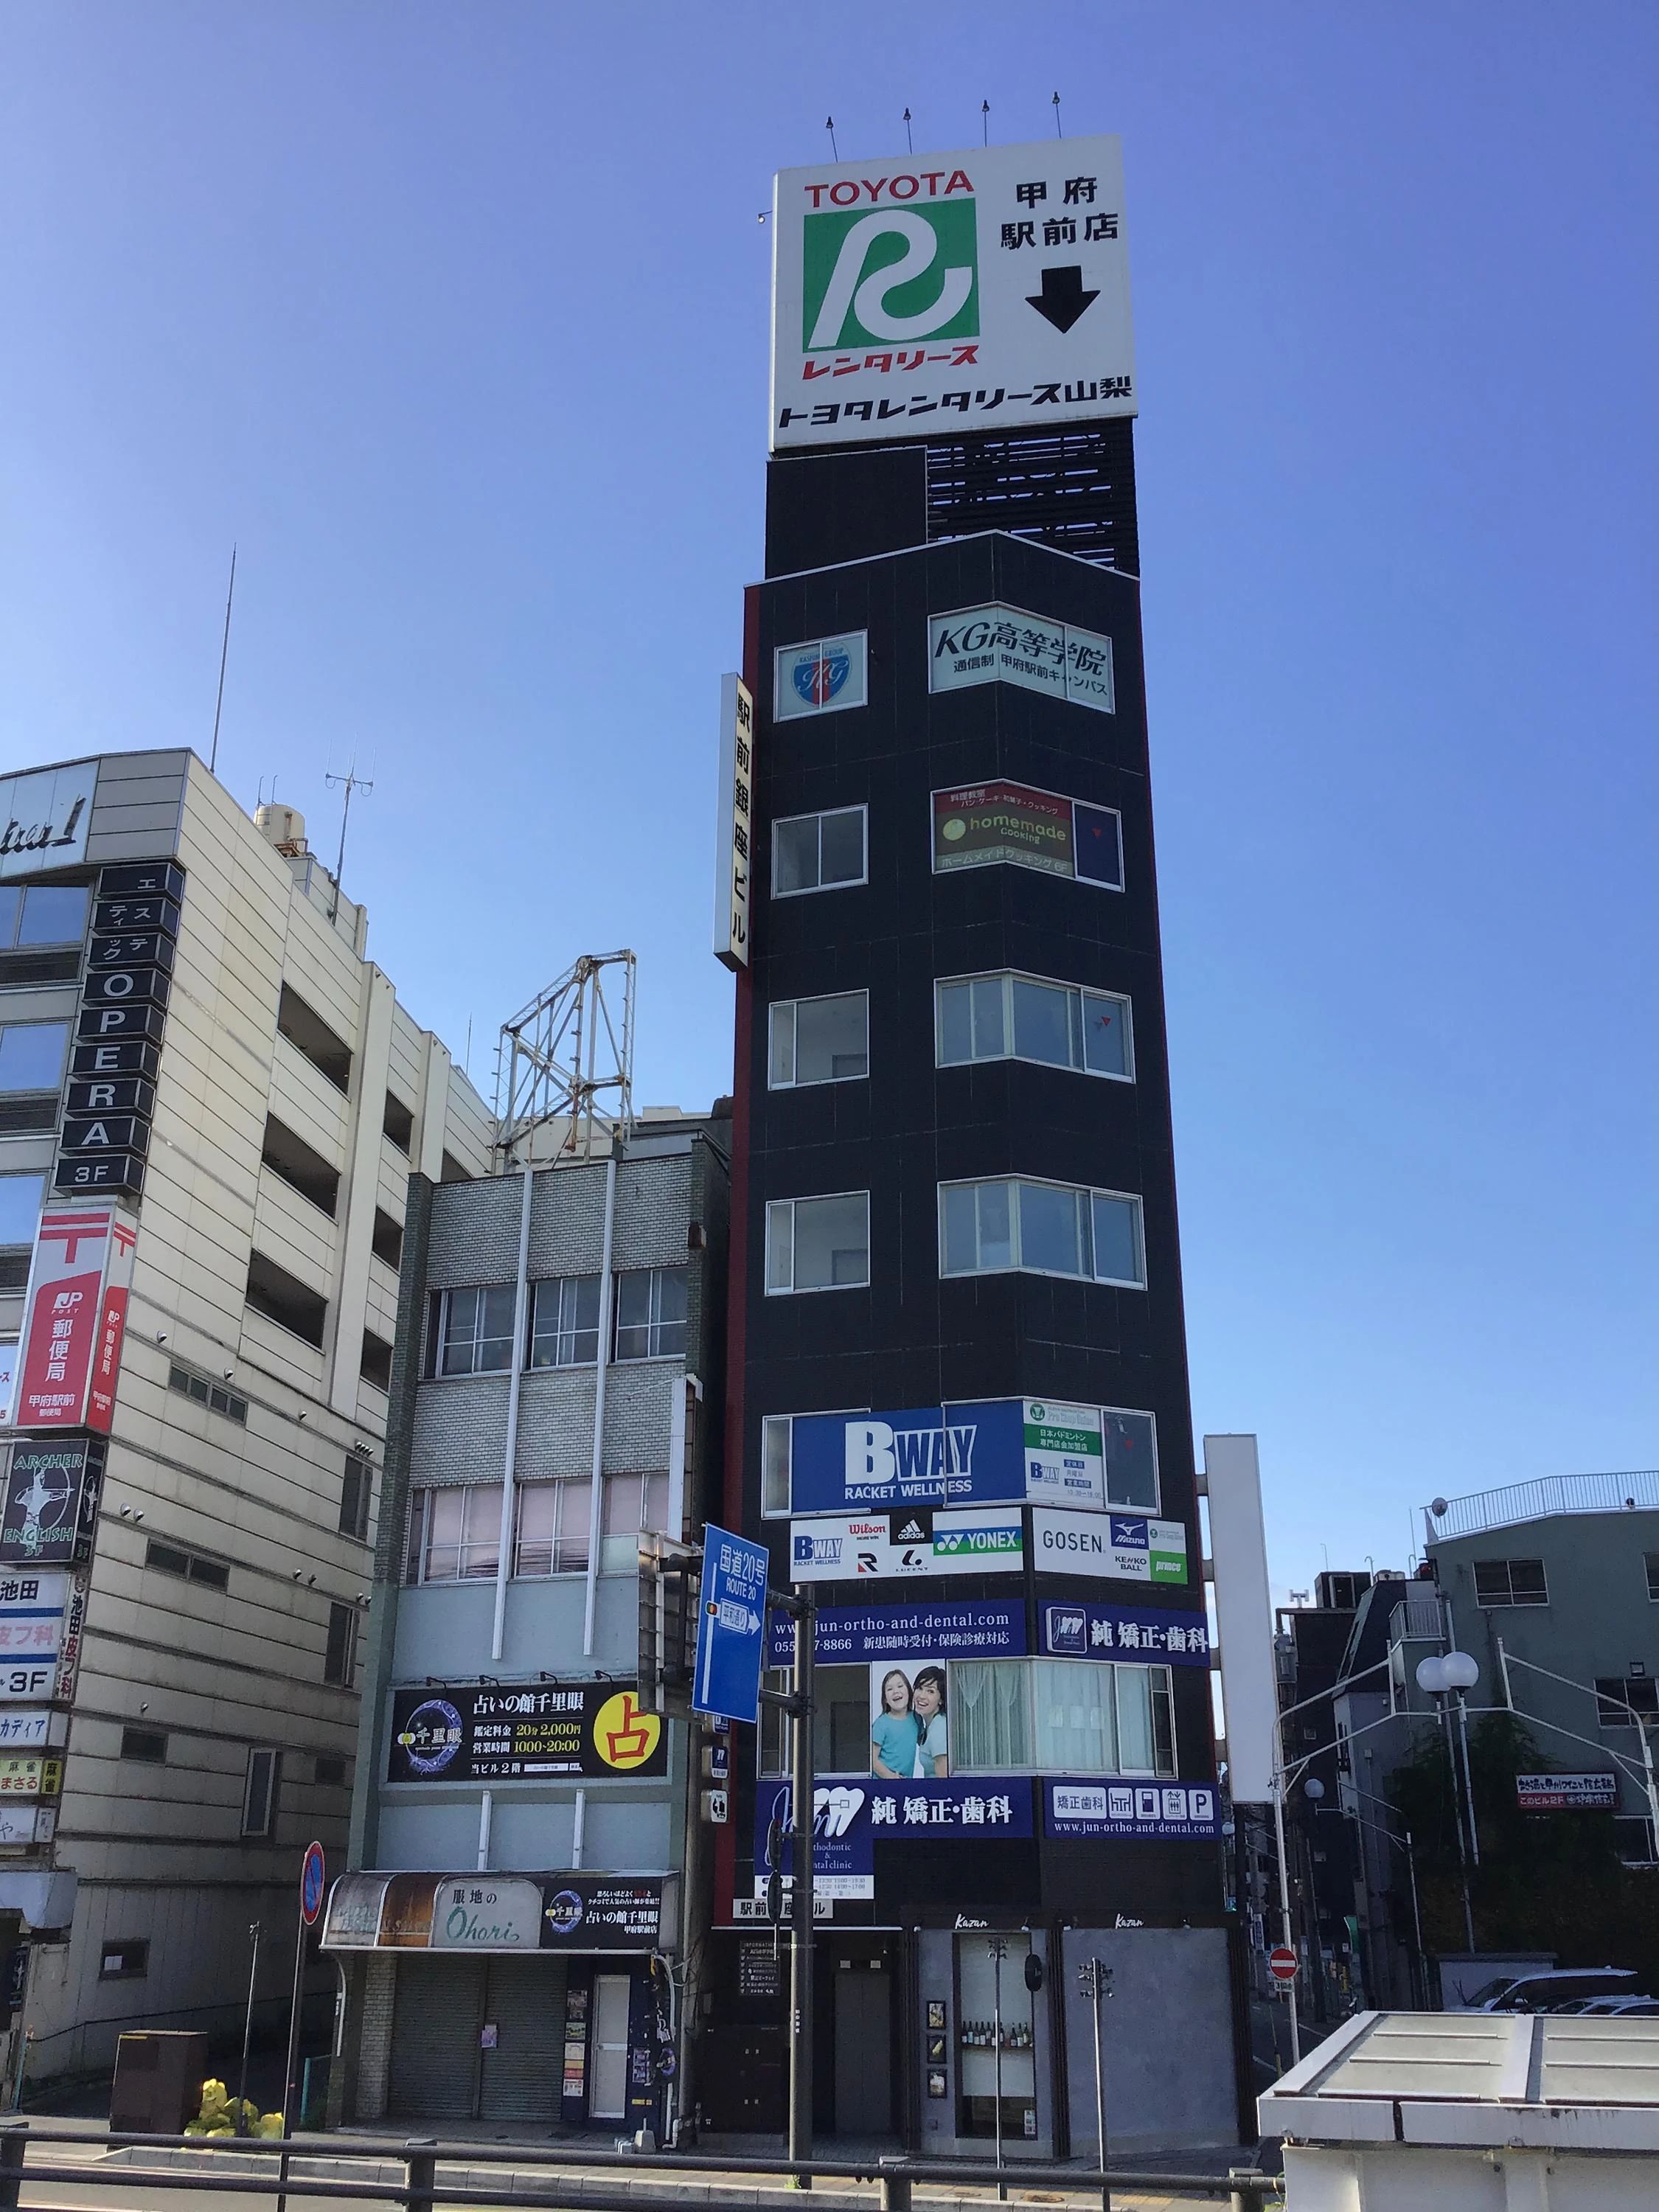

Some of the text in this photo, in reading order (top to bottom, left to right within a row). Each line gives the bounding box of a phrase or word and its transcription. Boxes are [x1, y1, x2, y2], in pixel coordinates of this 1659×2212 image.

[804, 170, 975, 208] TOYOTA
[1017, 177, 1098, 209] 甲府
[1001, 213, 1119, 250] 駅前店
[803, 345, 978, 380] レンタリース
[779, 376, 1133, 428] トヨタレンタリース山梨
[954, 653, 994, 673] 通信制
[731, 691, 751, 945] 駅前銀座ビル
[970, 815, 1066, 841] homemade
[942, 849, 1051, 867] ホームメイドクッキング
[81, 973, 134, 1147] OPERA
[74, 1166, 109, 1183] 3F
[44, 1318, 74, 1382] 郵便局
[102, 1329, 116, 1375] 郵便局
[29, 1393, 75, 1408] 甲府駅前
[1040, 1429, 1086, 1441] 日本バドミントン
[13, 1454, 83, 1470] ARCHER
[845, 1479, 973, 1500] RACKET WELLNESS
[3, 1527, 73, 1543] ENGLISH
[849, 1523, 886, 1534] Wilson
[898, 1531, 925, 1540] adidas
[967, 1531, 1018, 1550] YONEX
[1043, 1530, 1102, 1553] GOSEN
[24, 1545, 44, 1557] 3F
[720, 1543, 765, 1586] 国道20号
[1121, 1563, 1142, 1571] BALL
[0, 1580, 39, 1601] 池田
[726, 1576, 757, 1601] ROUTE 20
[723, 1604, 745, 1628] 平和通り
[60, 1593, 83, 1698] 池田皮フ科
[775, 1638, 852, 1653] 0557-8866
[10, 1671, 48, 1692] 3F
[473, 1691, 584, 1714] 占いの館千里眼
[0, 1718, 46, 1738] カディア
[416, 1727, 462, 1744] 千里眼
[473, 1722, 581, 1737] 鑑定料金 20分 2,000円
[606, 1694, 650, 1763] 占
[473, 1741, 510, 1754] 営業時間
[8, 1761, 37, 1773] 麻雀
[1, 1777, 38, 1790] まさる
[45, 1762, 58, 1792] 麻雀
[1057, 1795, 1103, 1810] 矯正歯科
[1195, 1793, 1207, 1813] P
[1054, 1821, 1214, 1834] www.jun-ortho-and-dental.com
[813, 1842, 852, 1851] thodontic
[830, 1860, 852, 1869] clinic
[453, 1888, 497, 1905] 服地の
[585, 1910, 658, 1924] 占いの館千里眼
[740, 1902, 825, 1916] 駅前座ル
[624, 1925, 658, 1934] 甲府駅前店
[955, 1913, 990, 1929] Kazan
[1115, 1913, 1144, 1928] Kazan
